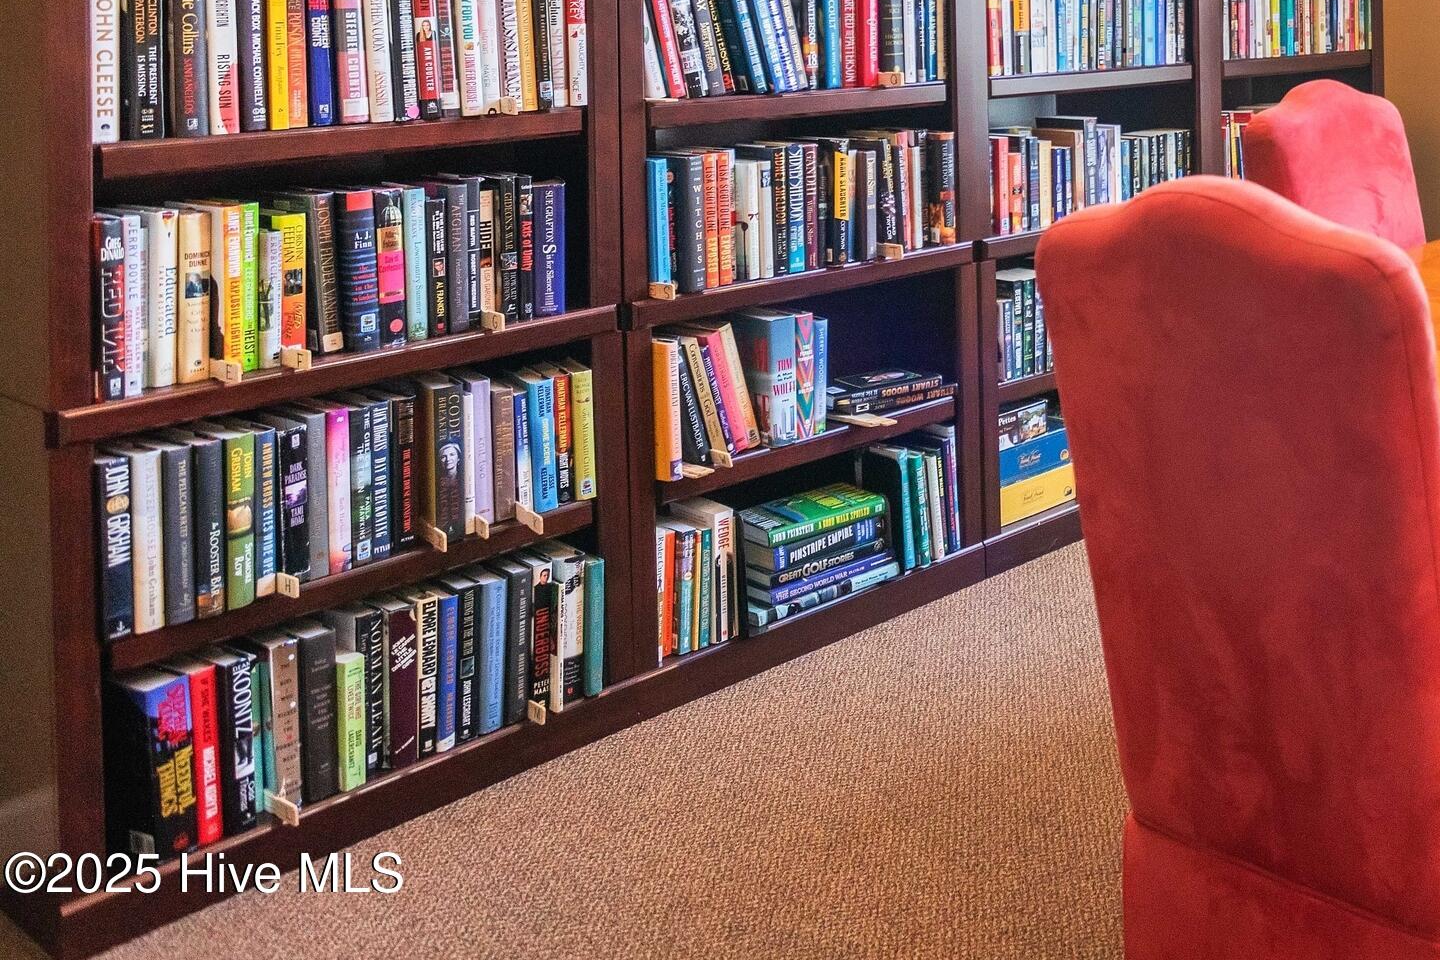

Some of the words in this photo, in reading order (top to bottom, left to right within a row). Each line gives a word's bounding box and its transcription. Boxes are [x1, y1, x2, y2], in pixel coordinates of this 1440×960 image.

[148, 0, 158, 35] CLINTON
[215, 0, 229, 27] CRICHTON
[252, 15, 261, 30] BOX
[461, 5, 473, 20] FOR
[844, 13, 855, 29] RED
[181, 13, 199, 55] Collins
[345, 12, 359, 54] STEPHEN
[463, 22, 474, 40] YOU
[149, 45, 158, 61] THE
[252, 33, 262, 65] MICHAEL
[845, 36, 856, 82] PATTERSON
[138, 63, 147, 97] MISSING
[148, 62, 158, 104] PRESIDENT
[217, 54, 232, 87] RISING
[348, 58, 361, 98] COONTS
[465, 53, 476, 81] JENNIFER
[96, 50, 114, 118] CLEESE
[184, 58, 194, 116] SANTANGELOS
[218, 90, 232, 109] SUN
[253, 67, 263, 106] CONNELLY
[705, 166, 715, 184] LISA
[719, 164, 728, 182] LISA
[774, 152, 785, 182] SIDNEY
[788, 150, 804, 180] SIDNEY
[839, 157, 847, 178] KARIN
[545, 190, 554, 205] SUE
[705, 186, 717, 233] SCOTTOLINE
[719, 184, 730, 231] SCOTTOLINE
[775, 185, 787, 224] SHELDON
[789, 181, 804, 223] SHELDON
[840, 180, 848, 217] SLAUGHTER
[128, 222, 138, 260] JERRY
[451, 205, 462, 252] AFGHAN
[480, 220, 493, 248] HIDE
[522, 220, 532, 238] Axis
[545, 206, 554, 243] GRAFTON
[283, 226, 295, 263] FEEHAN
[522, 239, 532, 248] of
[543, 244, 557, 254] S
[706, 237, 718, 273] EXPOSED
[720, 235, 731, 270] EXPOSED
[520, 249, 533, 272] Unity
[546, 260, 554, 269] for
[128, 264, 139, 300] DOYLE
[435, 281, 443, 290] AL
[546, 270, 554, 292] Silence
[165, 266, 177, 336] Educated
[436, 290, 445, 317] FRANKEN
[244, 329, 255, 355] HEIST
[687, 343, 707, 393] Conversations
[703, 398, 713, 417] God
[777, 357, 793, 372] TOM
[680, 372, 691, 391] ERIC
[881, 385, 909, 398] WOODS
[911, 379, 940, 391] STUART
[448, 394, 461, 438] CODE
[537, 385, 545, 418] KELLERMAN
[544, 385, 552, 414] JONATHAN
[684, 392, 695, 407] VAN
[438, 397, 447, 441] BREAKER
[687, 408, 705, 450] LUSTBADER
[998, 415, 1017, 427] Pettes
[106, 466, 129, 496] JOHN
[230, 448, 243, 493] GRISHAM
[243, 452, 253, 478] JOHN
[541, 467, 549, 500] KELLERMAN
[107, 512, 130, 568] GRISHAM
[717, 517, 731, 549] WEDGE
[790, 538, 827, 563] PINSTRIPE
[827, 525, 854, 547] EMPIRE
[209, 529, 221, 575] ROOSTER
[233, 555, 244, 576] ROW
[778, 570, 803, 583] GREAT
[802, 559, 828, 576] GOLF
[827, 551, 855, 568] STORIES
[210, 576, 222, 597] BAR
[422, 602, 437, 635] ELMORE
[370, 619, 383, 696] NORMAN
[422, 637, 437, 675] LEONARD
[535, 607, 550, 678] UNDERBOSS
[421, 677, 435, 695] GET
[232, 669, 253, 738] KOONTZ
[421, 695, 436, 730] SHORTY
[371, 700, 383, 749] LEAR
